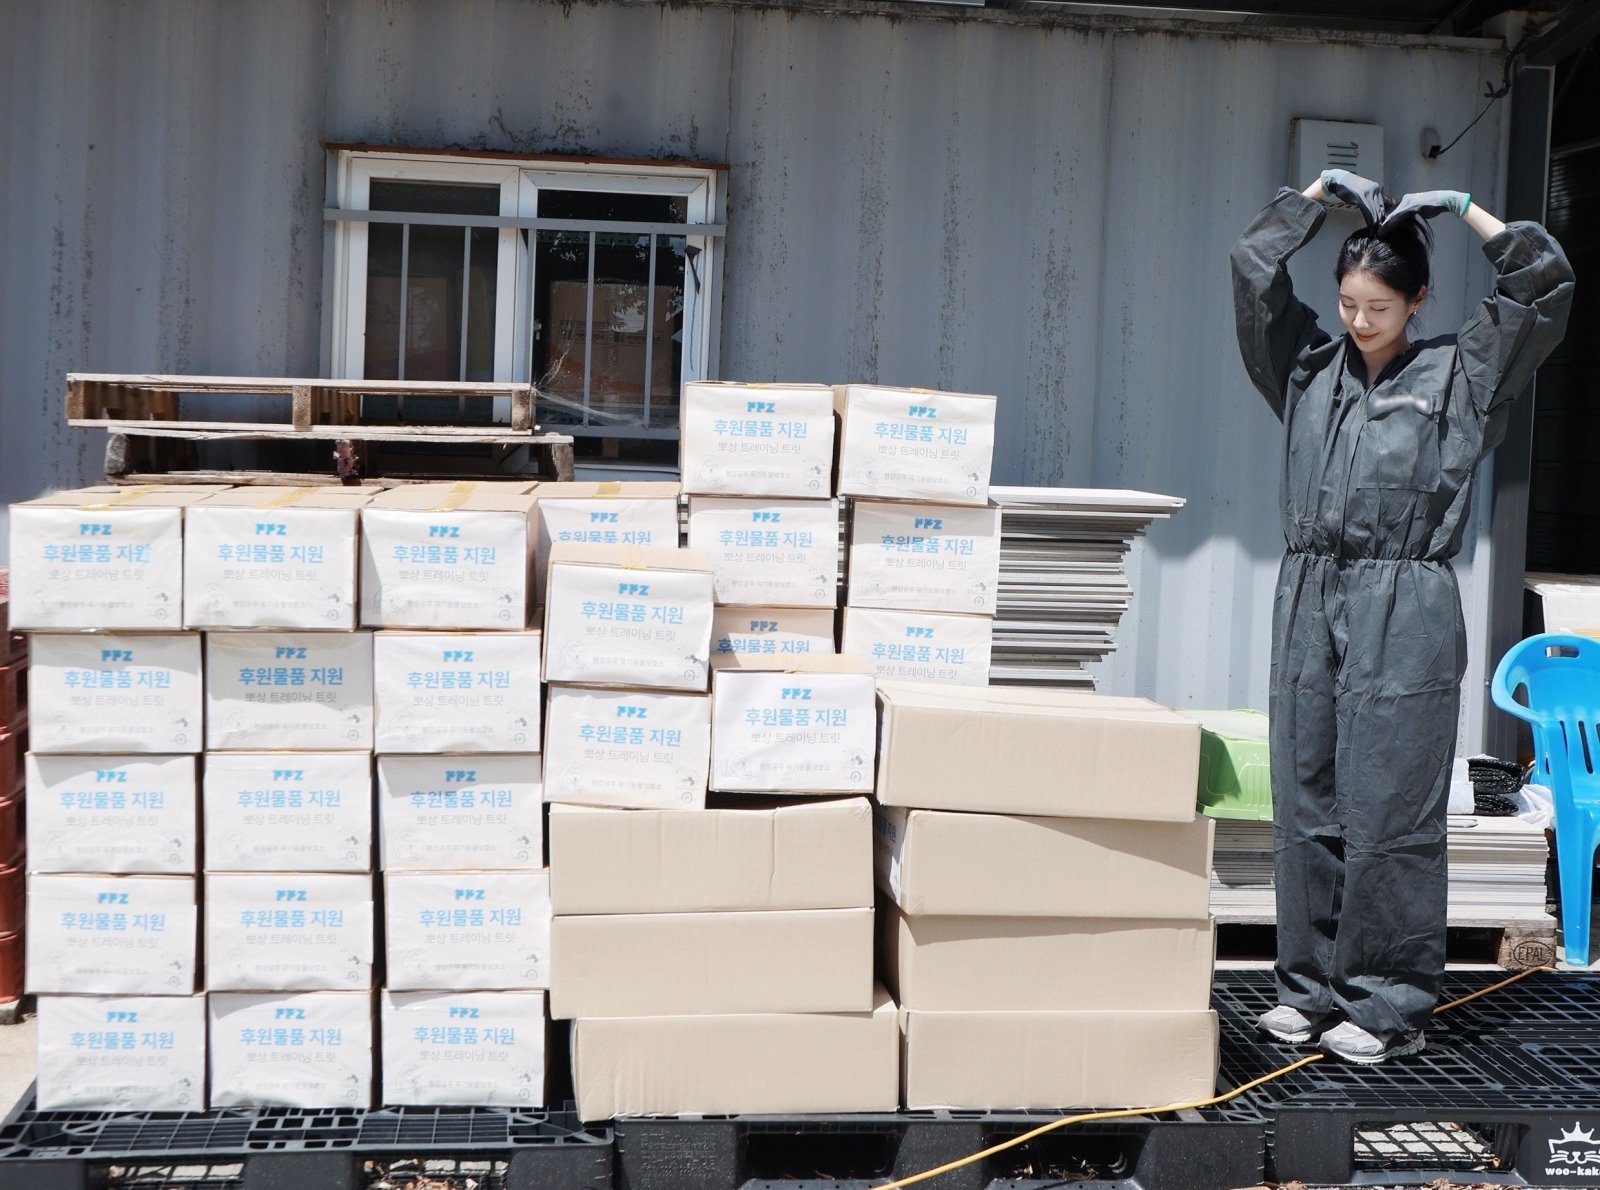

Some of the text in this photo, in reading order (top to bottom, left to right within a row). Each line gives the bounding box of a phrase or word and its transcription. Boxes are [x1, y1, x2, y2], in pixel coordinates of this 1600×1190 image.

[713, 419, 807, 439] 후원물품 지원
[873, 421, 967, 445] 후원물품 지원
[621, 530, 651, 546] 지원
[718, 529, 812, 548] 후원물품 지원
[880, 534, 973, 556] 후원물품 지원
[42, 544, 112, 563] 후원물품
[217, 543, 323, 564] 후원물품 지원
[392, 544, 495, 565] 후원물품 지원
[580, 600, 683, 625] 후원물품 지원
[717, 638, 809, 654] 후원물품 지원
[871, 642, 964, 665] 후원물품 지원
[63, 670, 170, 689] 후원물품 지원
[238, 667, 343, 686] 후원물품 지원
[406, 670, 510, 689] 후원물품 지원
[745, 707, 847, 727] 후원물품 지원
[579, 723, 681, 747] 후원물품 지원
[59, 790, 164, 809] 후원물품 지원
[237, 789, 341, 808] 후원물품 지원
[410, 789, 512, 808] 후원물품 지원
[60, 911, 165, 931] 후원물품 지원
[239, 909, 343, 928] 후원물품 지원
[419, 907, 521, 927] 후원물품 지원
[1518, 946, 1547, 962] EPAL
[69, 1031, 174, 1050] 후원물품 지원
[240, 1027, 341, 1046] 후원물품 지원
[413, 1026, 515, 1045] 후원물품 지원
[1545, 1166, 1600, 1176] woo-kak
